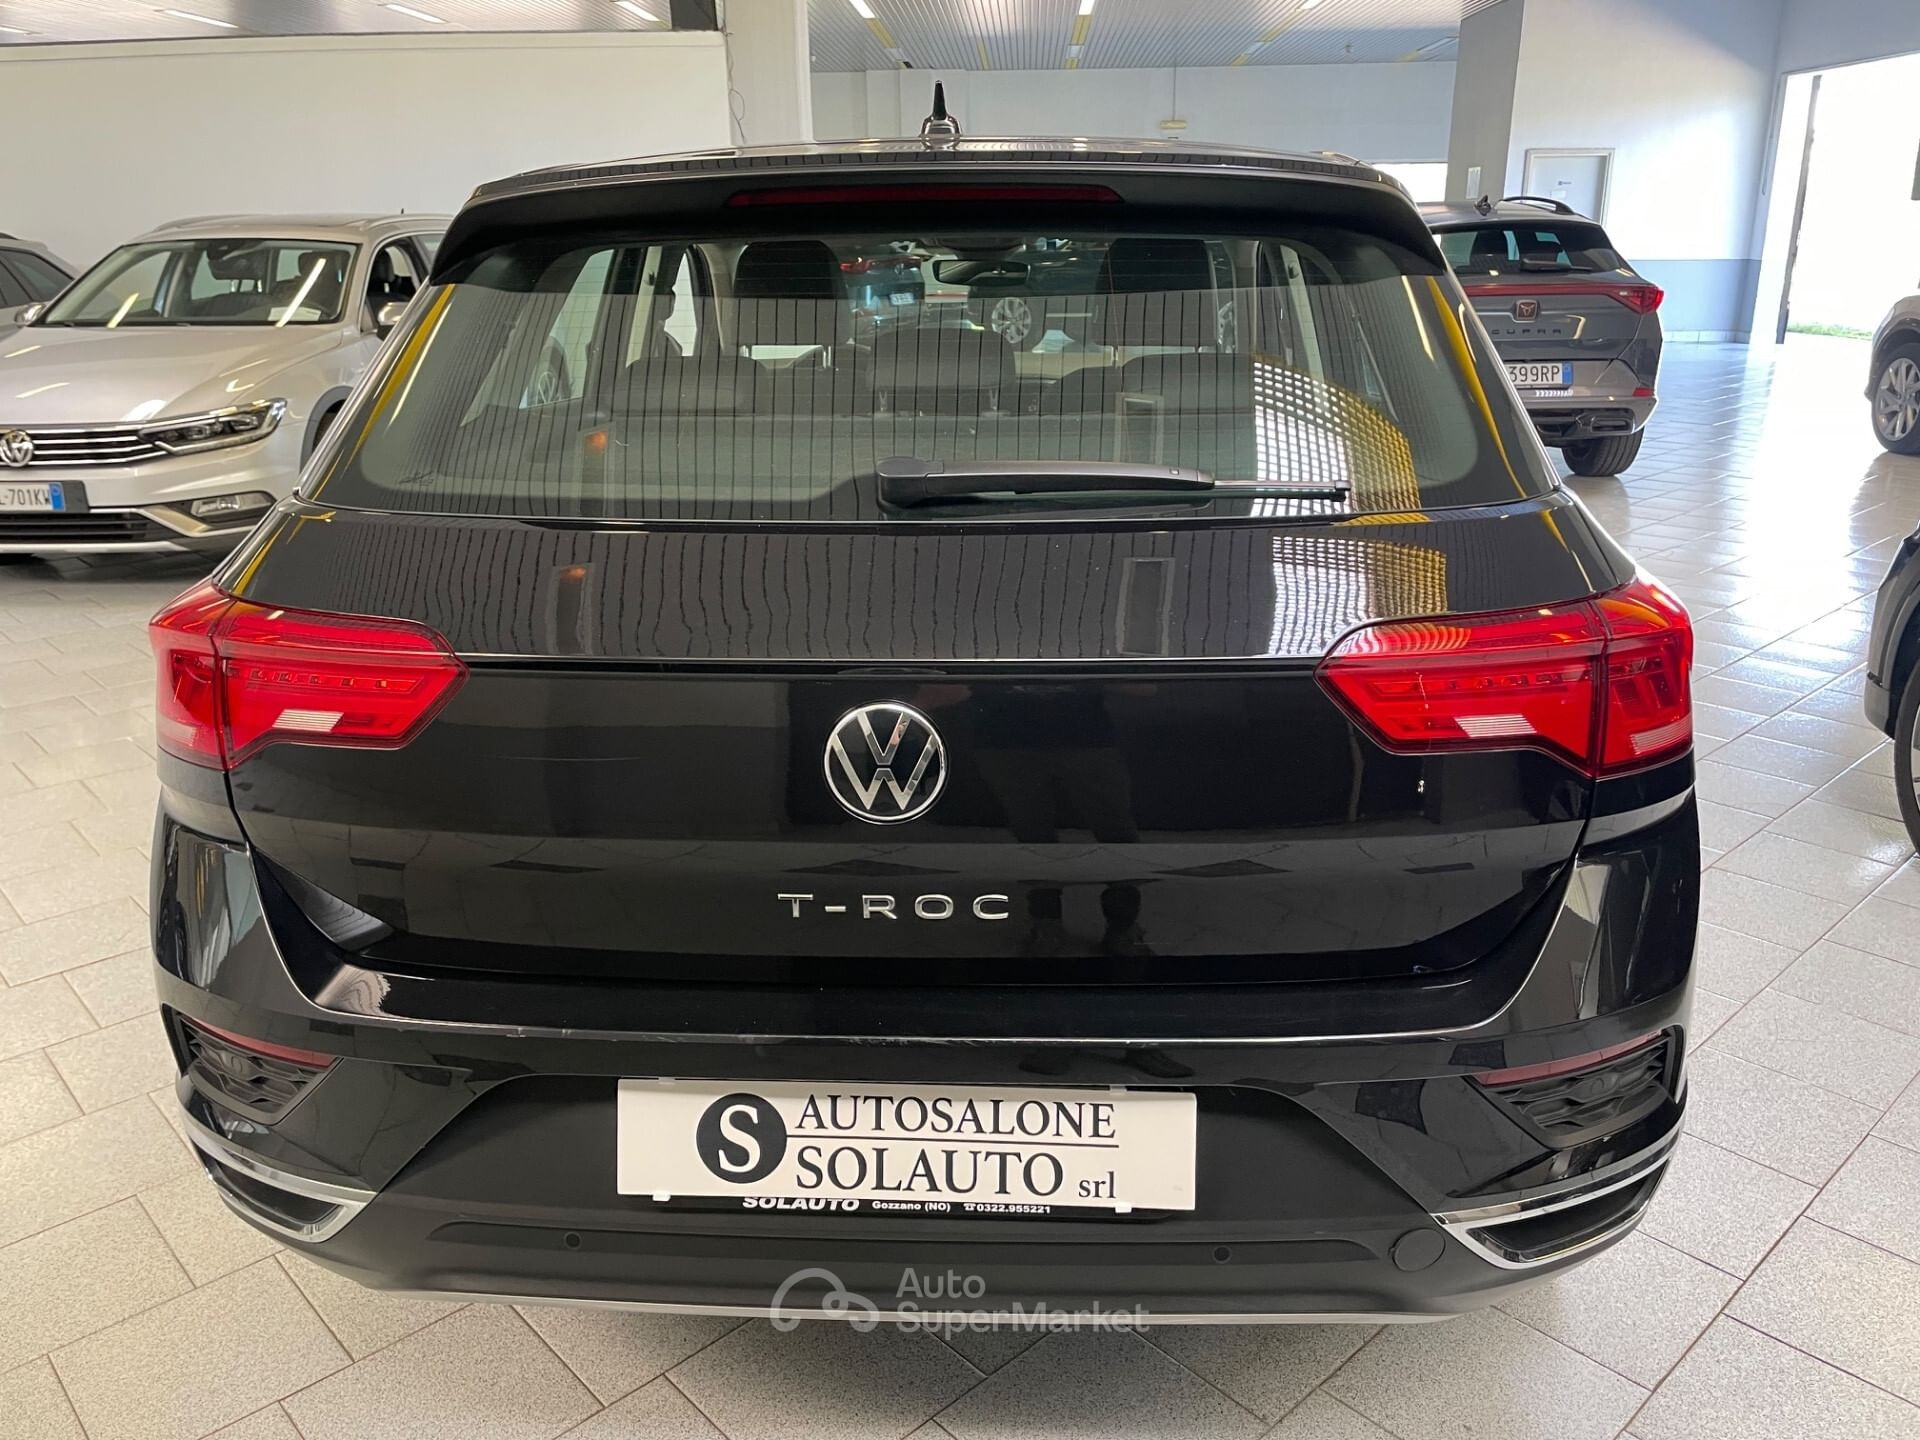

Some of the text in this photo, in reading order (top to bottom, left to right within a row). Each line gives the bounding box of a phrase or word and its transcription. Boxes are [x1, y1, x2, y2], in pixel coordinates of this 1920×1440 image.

[1508, 365, 1560, 383] 399RP
[777, 893, 1009, 920] T-ROC
[795, 1094, 1116, 1139] AUTOSALONE
[718, 1104, 763, 1174] S
[796, 1145, 1116, 1199] SOLAUTO srl
[742, 1196, 860, 1211] SOLAUTO
[871, 1200, 921, 1211] Gozzano
[923, 1202, 951, 1213] (NO)
